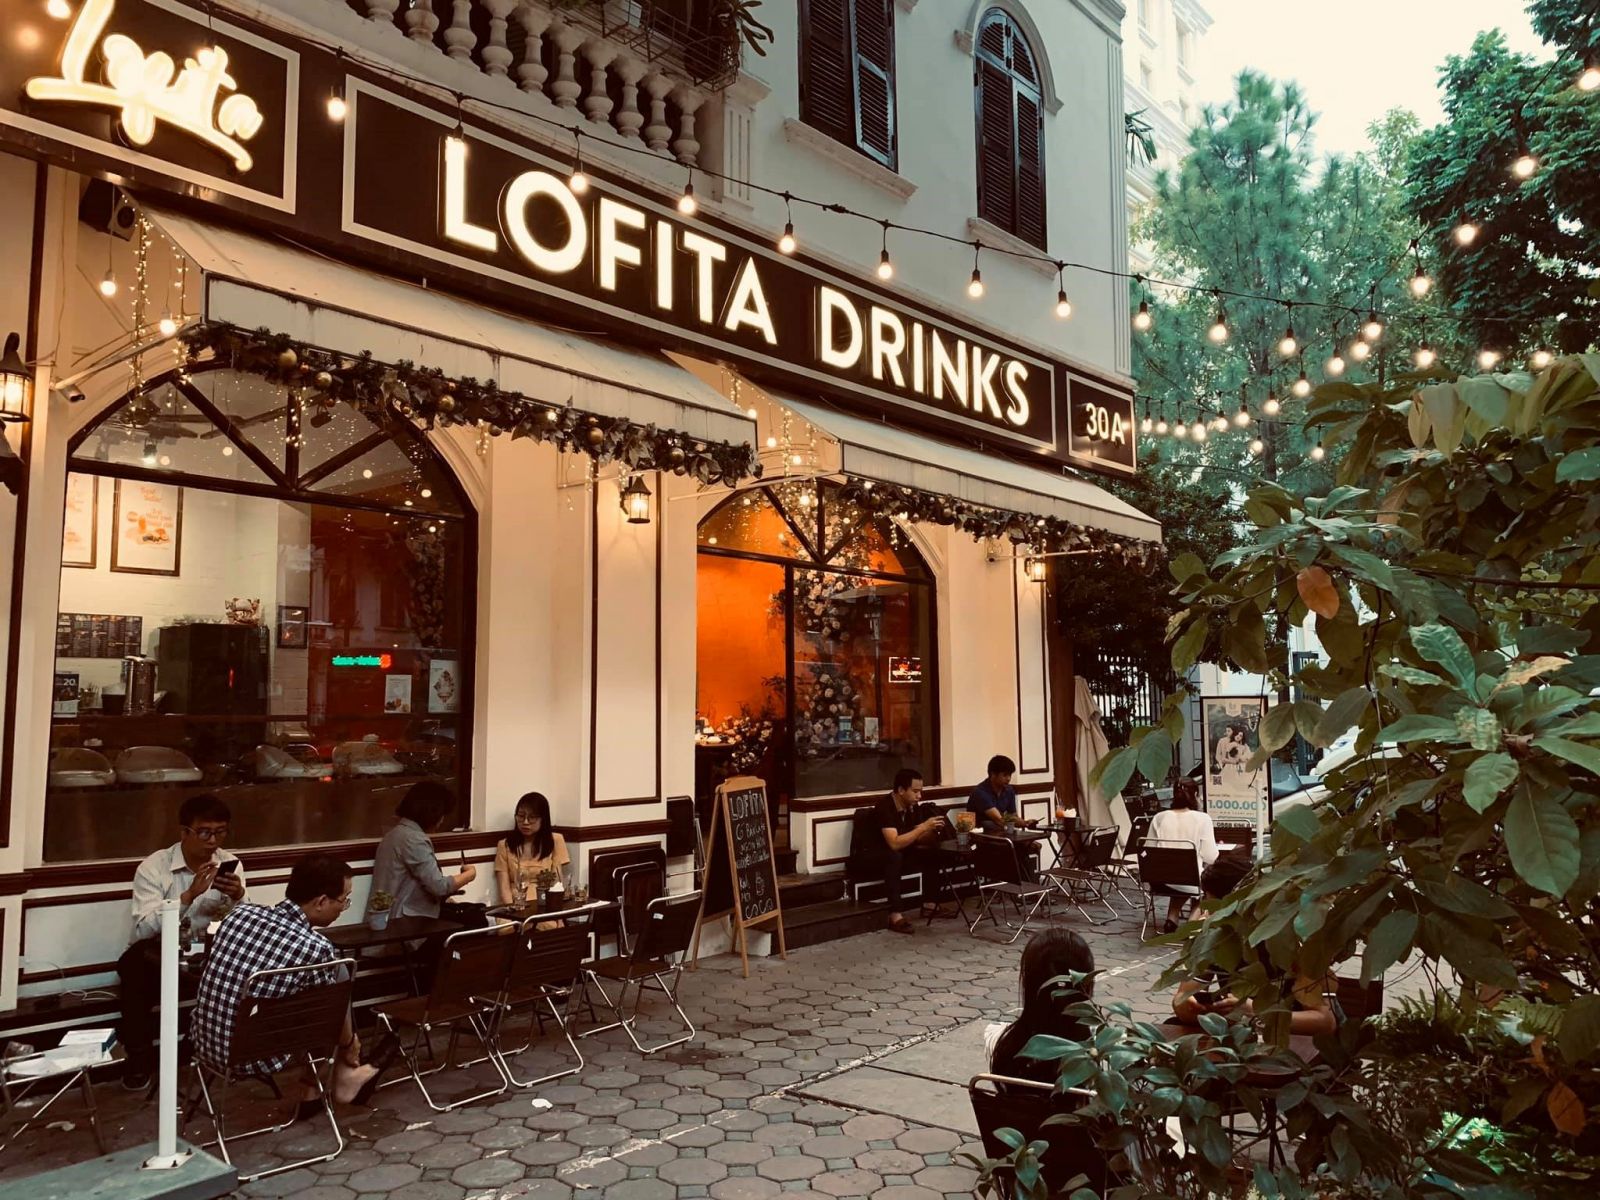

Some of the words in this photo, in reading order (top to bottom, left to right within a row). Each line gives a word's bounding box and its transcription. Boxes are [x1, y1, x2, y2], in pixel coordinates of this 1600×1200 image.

[444, 136, 778, 346] LOFITA
[820, 285, 1031, 428] DRINKS
[1085, 402, 1126, 445] 30A
